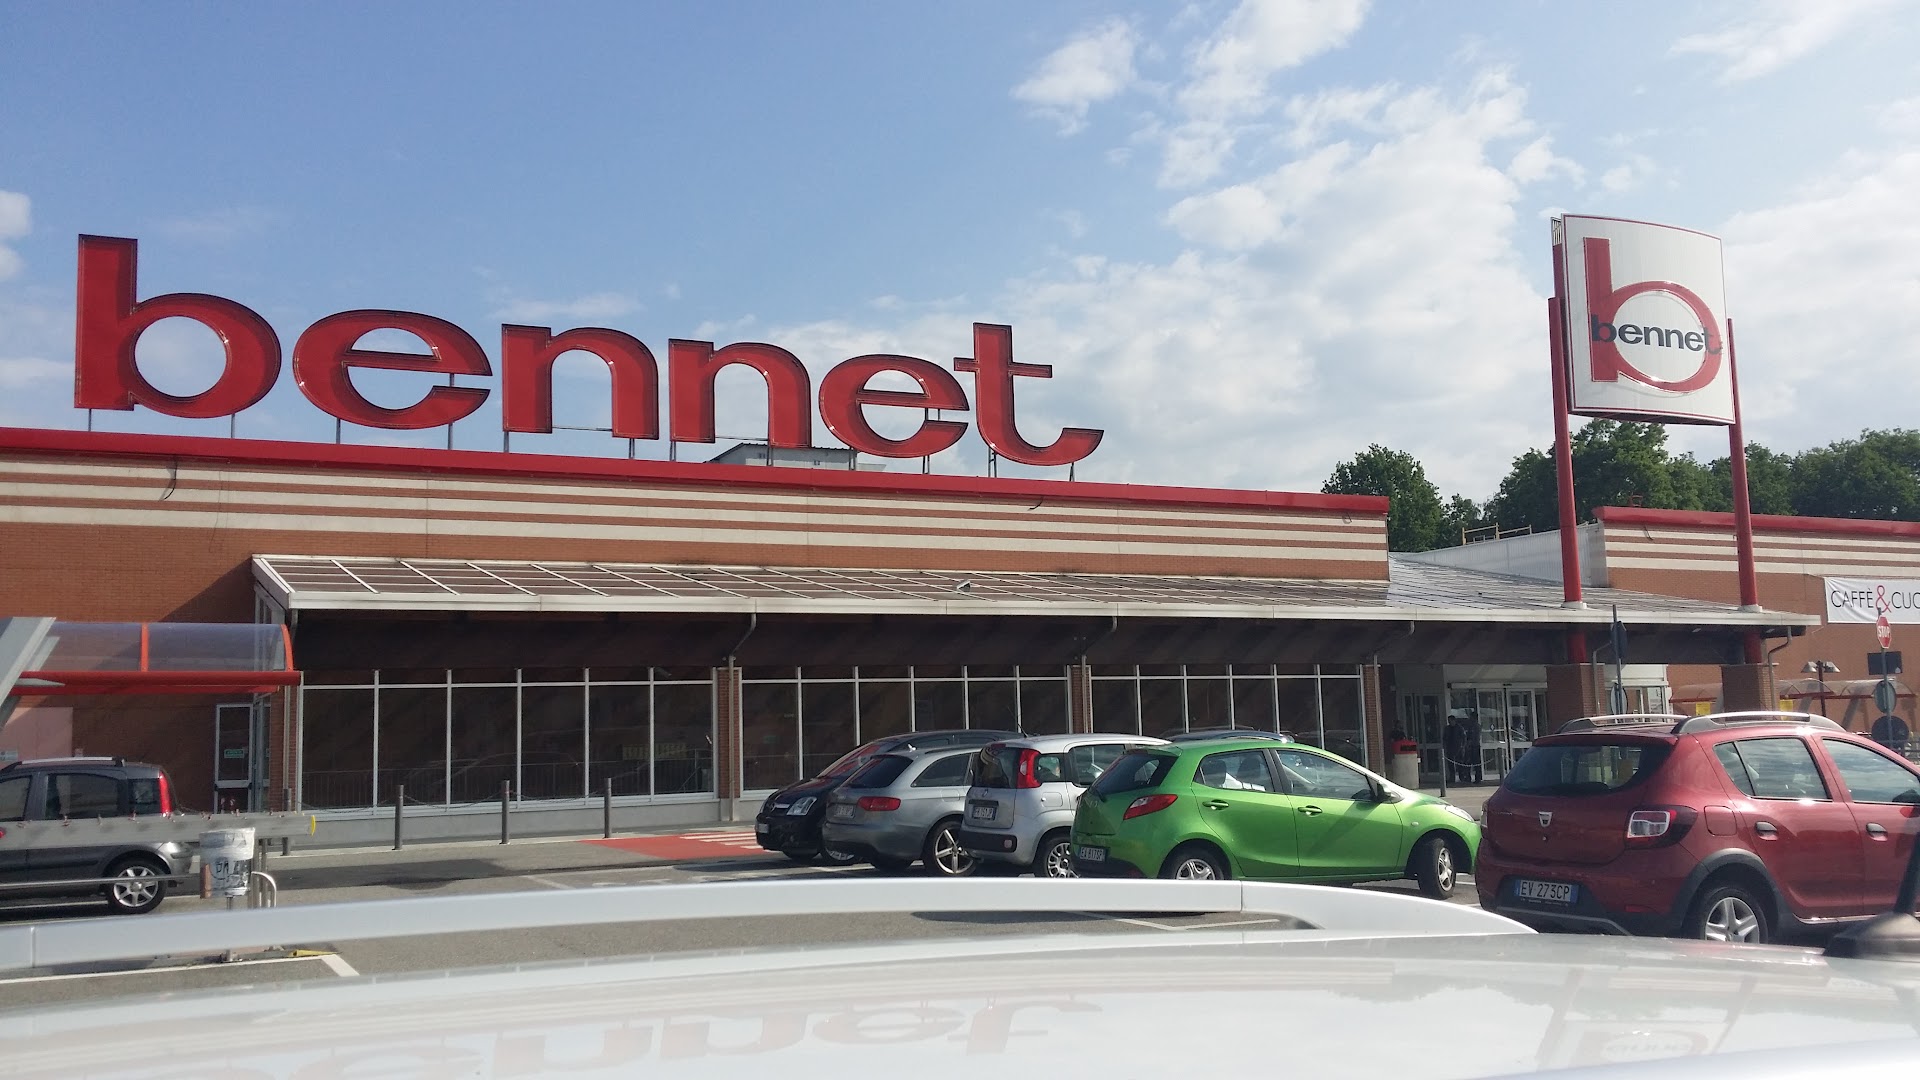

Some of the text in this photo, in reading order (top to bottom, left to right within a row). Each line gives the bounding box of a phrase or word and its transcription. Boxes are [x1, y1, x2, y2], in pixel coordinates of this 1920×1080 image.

[74, 233, 1104, 466] bennet
[1583, 237, 1722, 393] b
[1591, 314, 1723, 355] bennet
[1521, 881, 1570, 900] EV 273CP
